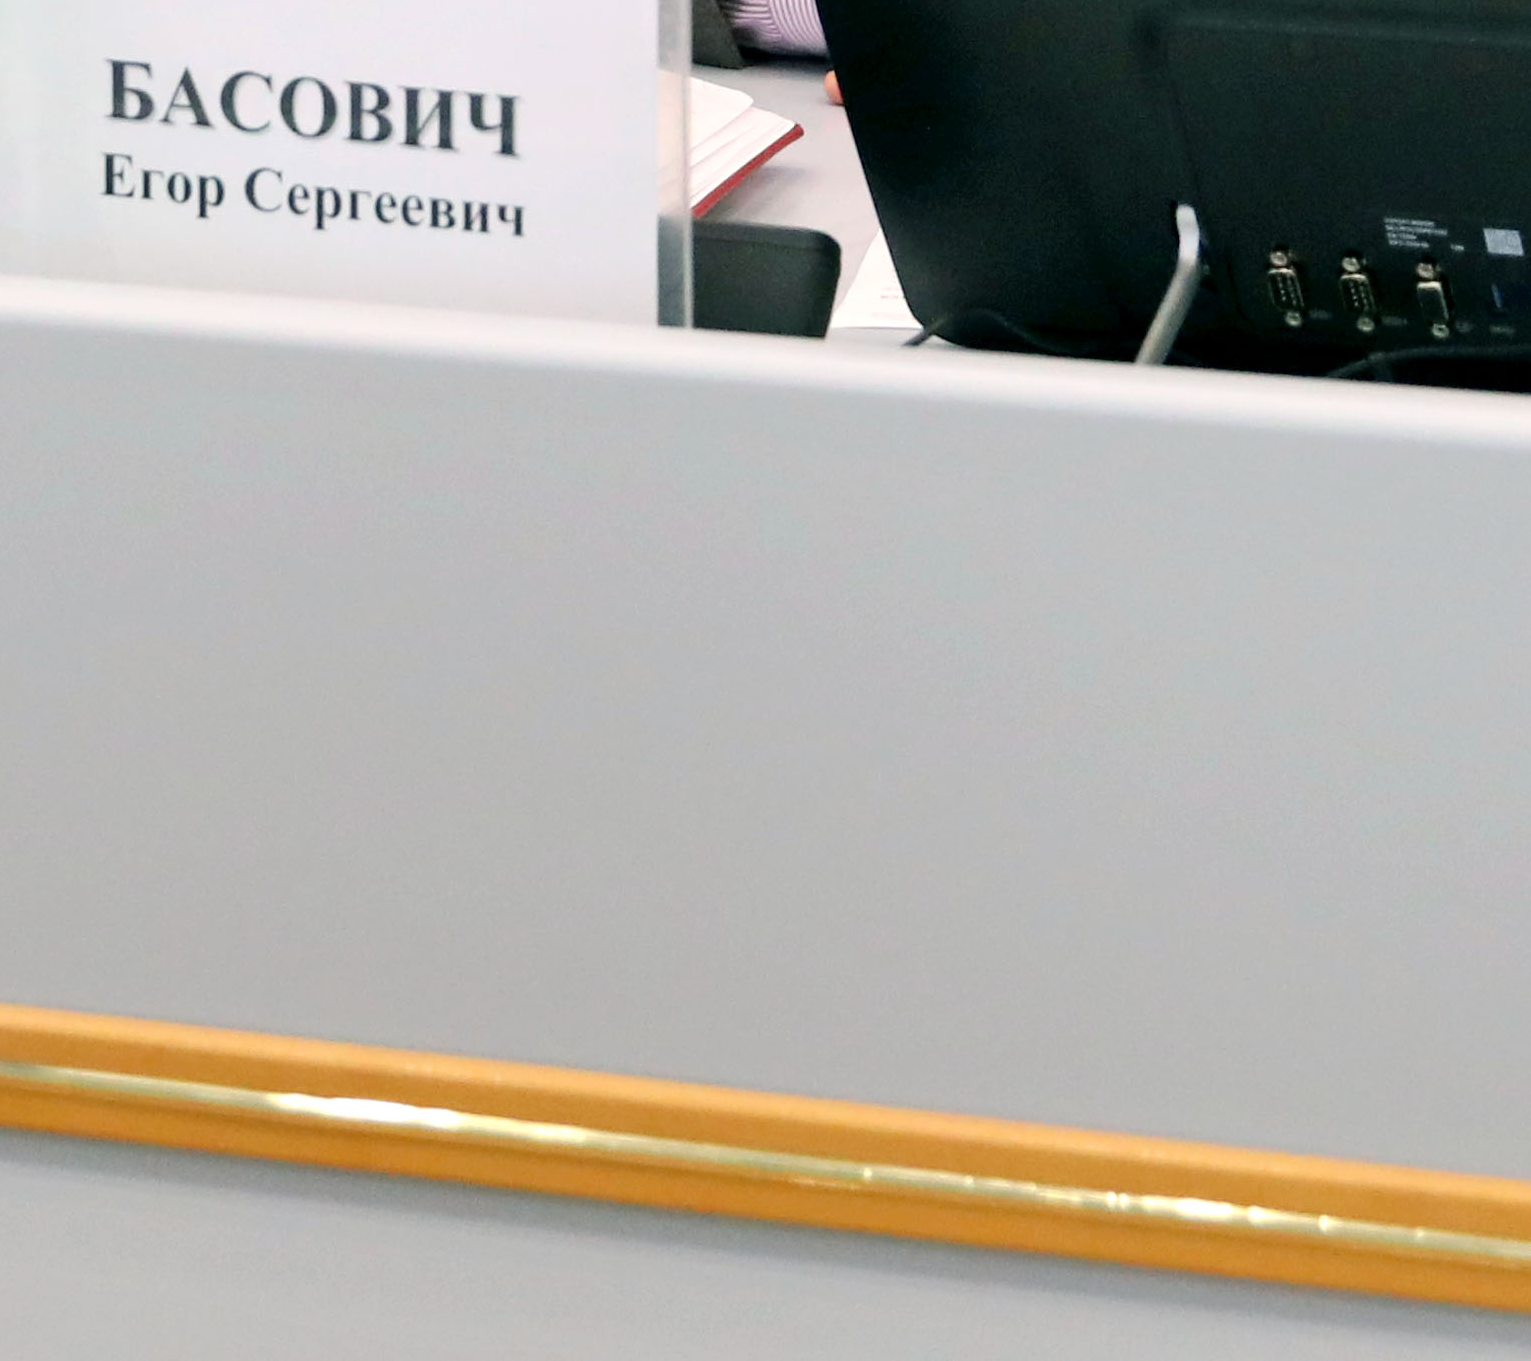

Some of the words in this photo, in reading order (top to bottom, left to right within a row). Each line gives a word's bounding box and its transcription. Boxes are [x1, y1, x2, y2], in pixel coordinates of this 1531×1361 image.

[103, 58, 523, 158] БАСОВИЧ
[100, 151, 226, 220] Егор
[243, 166, 526, 238] Сергеевич
